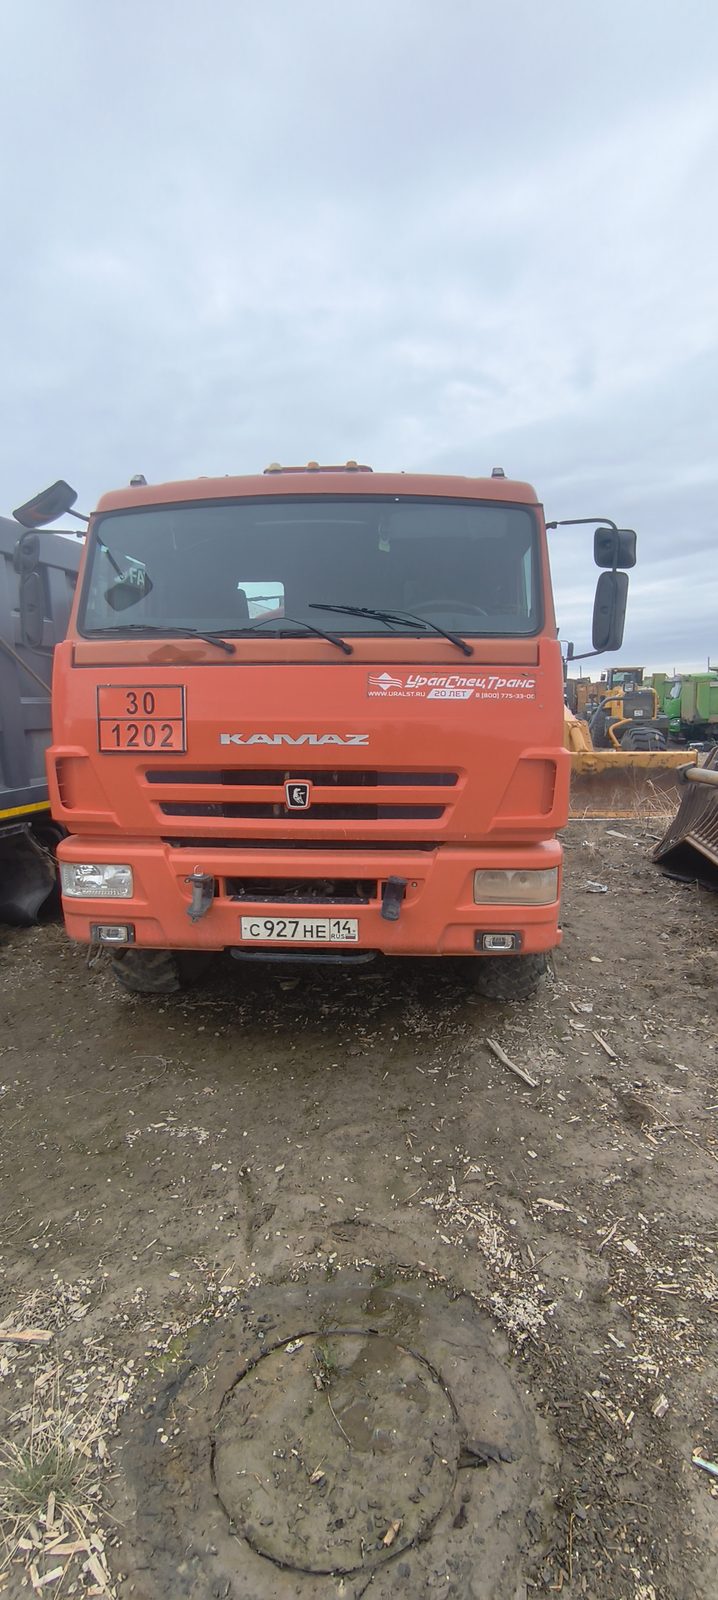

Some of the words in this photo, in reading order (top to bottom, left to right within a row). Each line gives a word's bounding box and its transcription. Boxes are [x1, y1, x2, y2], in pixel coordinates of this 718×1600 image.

[448, 690, 467, 698] ЛЕТ
[126, 692, 155, 714] 30
[111, 723, 173, 747] 1202
[220, 733, 369, 745] KAMAZ
[333, 921, 351, 934] 14
